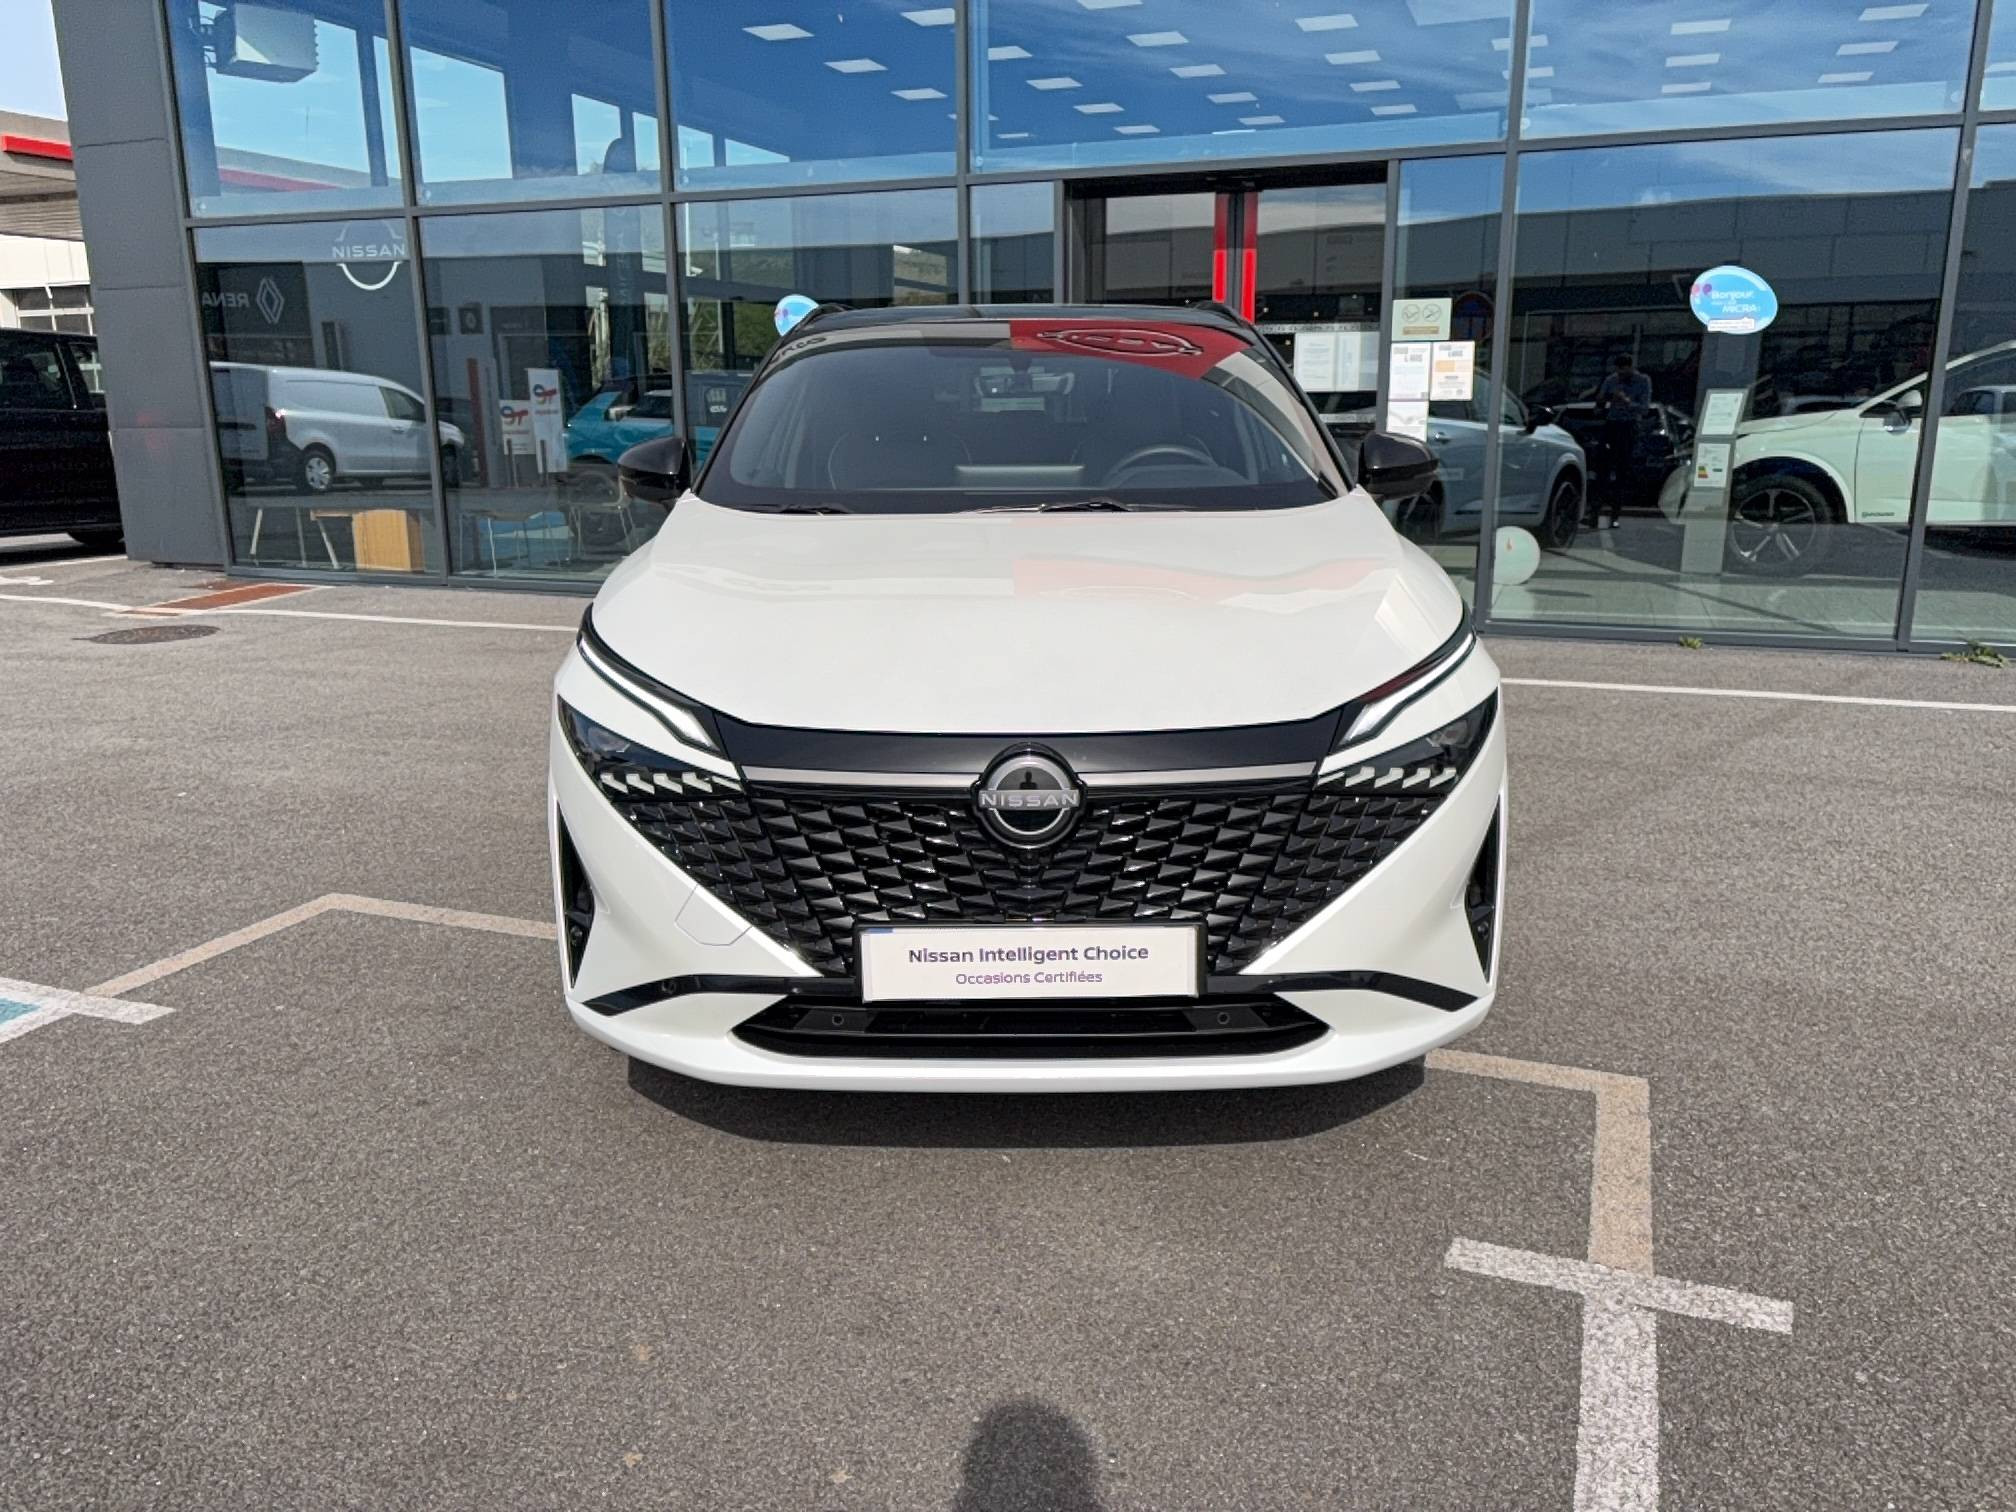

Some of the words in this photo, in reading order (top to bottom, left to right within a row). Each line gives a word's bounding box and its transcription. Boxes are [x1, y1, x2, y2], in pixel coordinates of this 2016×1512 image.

[332, 244, 405, 257] NISSAN
[981, 793, 1077, 807] NISSAN
[909, 948, 973, 964] Nissan
[979, 947, 1079, 966] Intelligent
[1084, 945, 1149, 961] Choice
[955, 971, 1031, 985] Occasions
[1034, 969, 1103, 984] Certifiées
